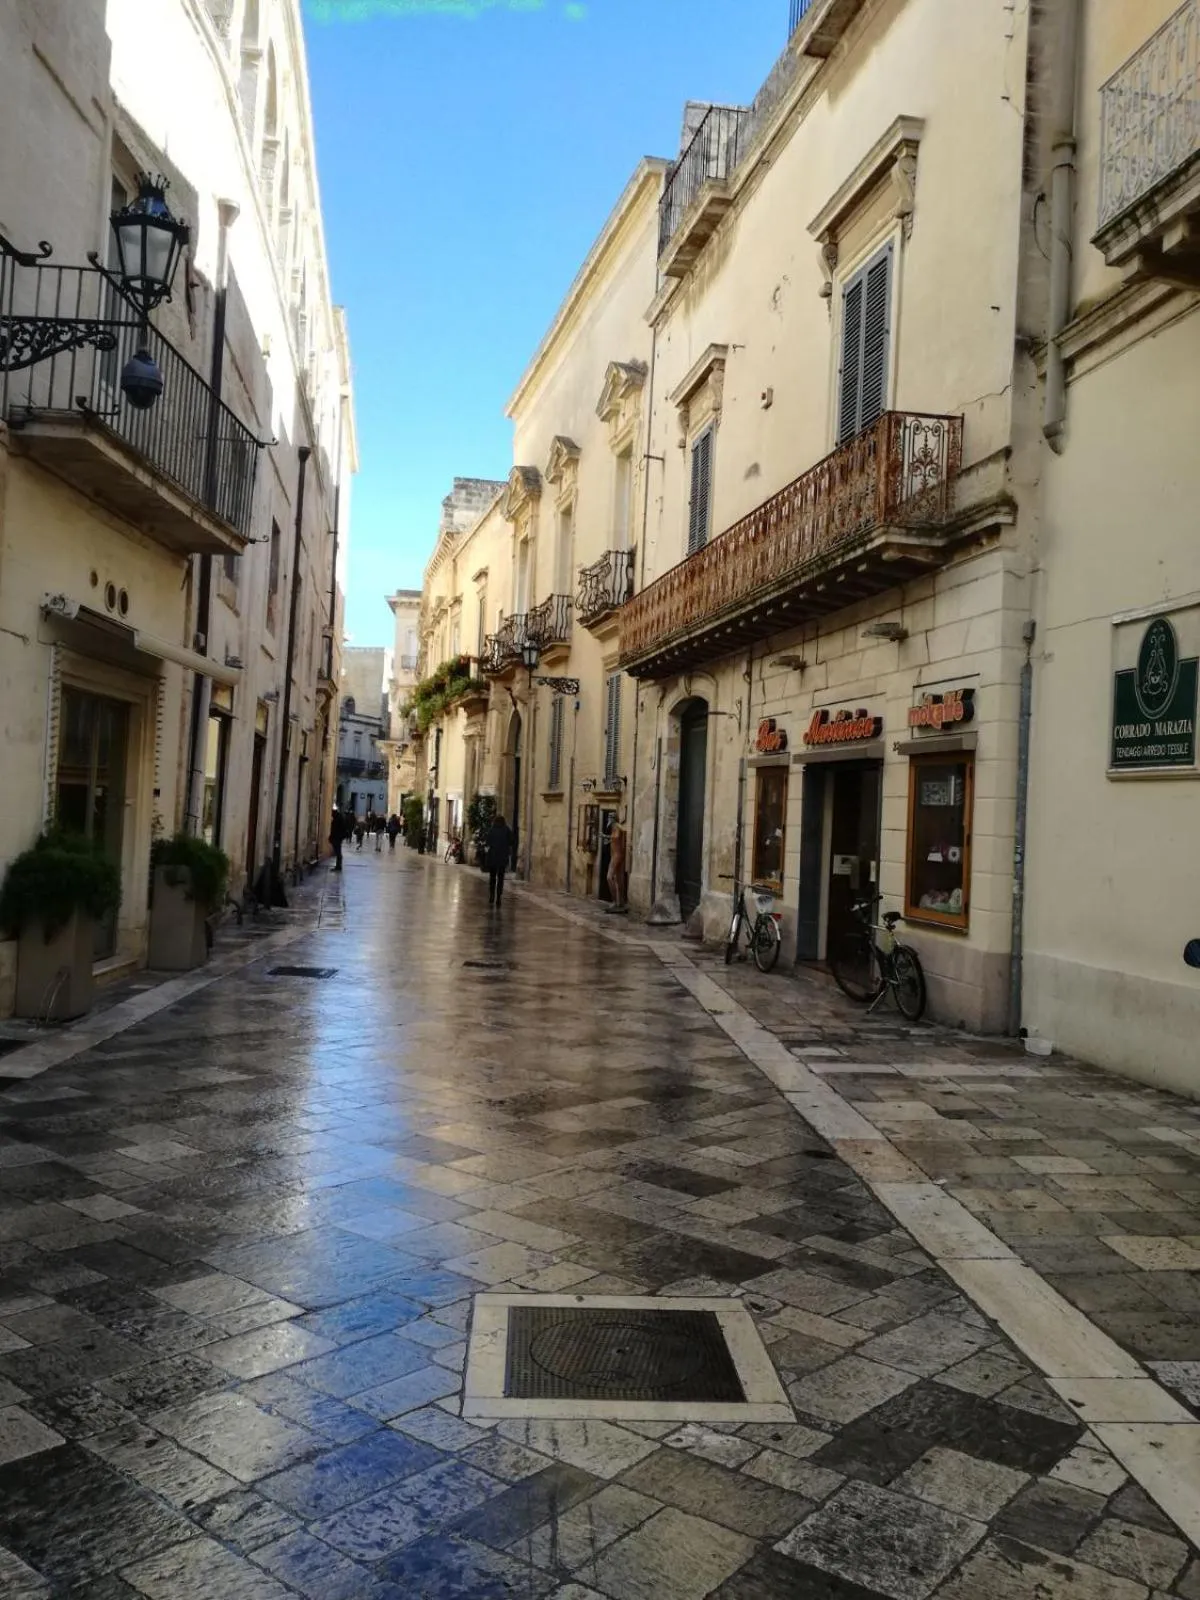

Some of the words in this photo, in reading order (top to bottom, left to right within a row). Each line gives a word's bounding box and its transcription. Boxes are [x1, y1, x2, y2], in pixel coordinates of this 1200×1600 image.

[1114, 723, 1151, 739] CORRADO
[1154, 719, 1193, 736] MARAZIA
[1167, 742, 1189, 755] TESSILE
